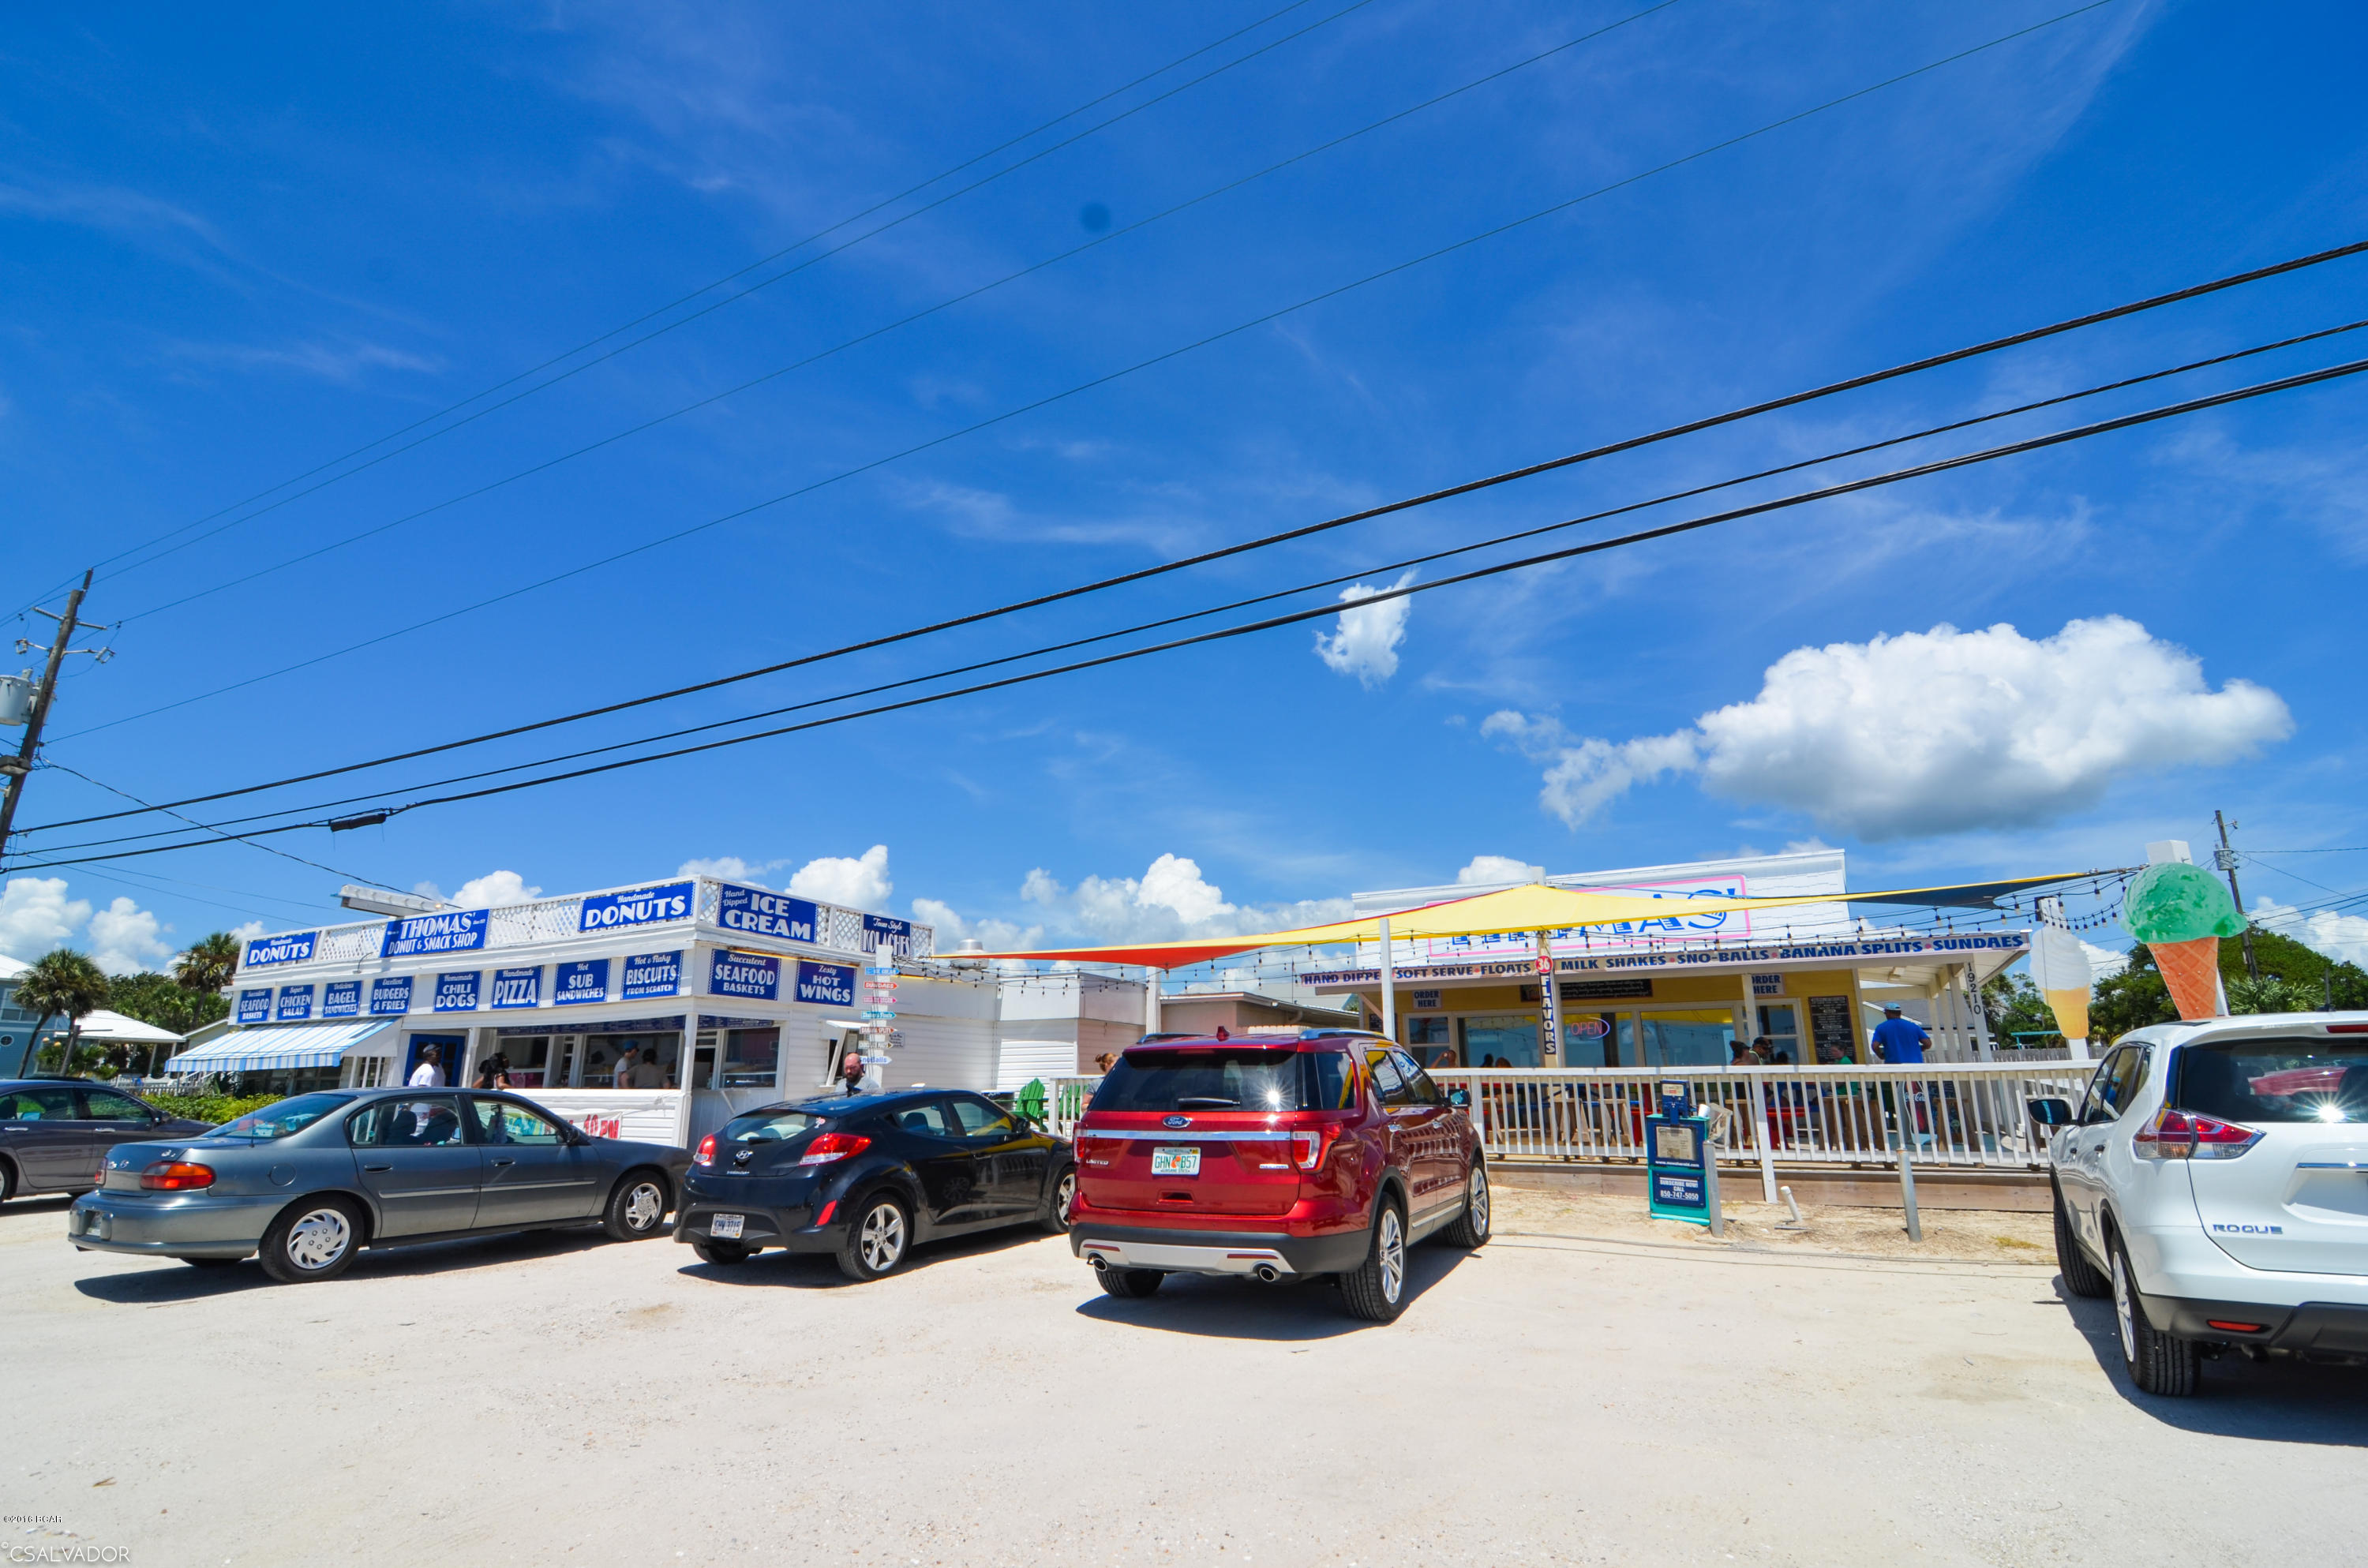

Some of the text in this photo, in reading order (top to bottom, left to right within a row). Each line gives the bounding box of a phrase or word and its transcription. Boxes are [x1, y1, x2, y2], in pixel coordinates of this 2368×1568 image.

[617, 892, 655, 904] Handmade
[725, 889, 745, 898] Hand
[723, 897, 747, 907] Dipped
[751, 893, 789, 916] ICE
[585, 896, 685, 927] DONUTS
[400, 912, 475, 939] THOMAS'
[725, 909, 811, 940] CREAM
[888, 920, 902, 933] Style
[388, 932, 478, 954] DONUT & SNACK SHOP
[862, 930, 910, 957] KOLACHES
[249, 942, 309, 964] DONUTS
[634, 956, 646, 964] Hot
[652, 954, 671, 964] Flaky
[728, 954, 766, 966] Succulent
[1305, 935, 2023, 985] HAND DIPPE SOFT SERVE FLOATS MILK SHAKES SNO-BALLS BANANA SPLITS SUNDAES
[818, 965, 837, 975] Zesty
[1537, 957, 1550, 971] 36
[568, 974, 593, 989] SUB
[626, 965, 676, 985] BISCUITS
[715, 964, 774, 985] SEAFOOD
[812, 975, 840, 986] HOT
[373, 987, 409, 1000] BURGERS
[443, 984, 471, 994] CHILI
[493, 979, 536, 1005] PIZZA
[556, 987, 604, 1001] SANDWICHES
[627, 984, 673, 995] FROM SCRATCH
[723, 982, 765, 994] BASKETS
[800, 984, 850, 1002] WINGS
[1414, 990, 1439, 999] ORDER
[1753, 985, 1778, 994] HERE
[1967, 963, 1981, 1016] 19210
[240, 998, 269, 1012] SEAFOOD
[280, 994, 312, 1008] CHICKEN
[328, 992, 356, 1005] BAGEL
[381, 1001, 405, 1010] FRIES
[436, 994, 476, 1008] DOGS
[1418, 999, 1437, 1008] HERE
[283, 1007, 305, 1016] SALAD
[324, 1003, 358, 1014] SANDWICHES
[1541, 975, 1555, 1053] FLAVORS
[1571, 1021, 1602, 1035] OPEN
[1168, 1117, 1183, 1125] Ford
[600, 1120, 619, 1139] PM
[1181, 1155, 1197, 1169] B57
[1660, 1190, 1699, 1199] 850-747-5050
[2213, 1225, 2283, 1234] ROGUE
